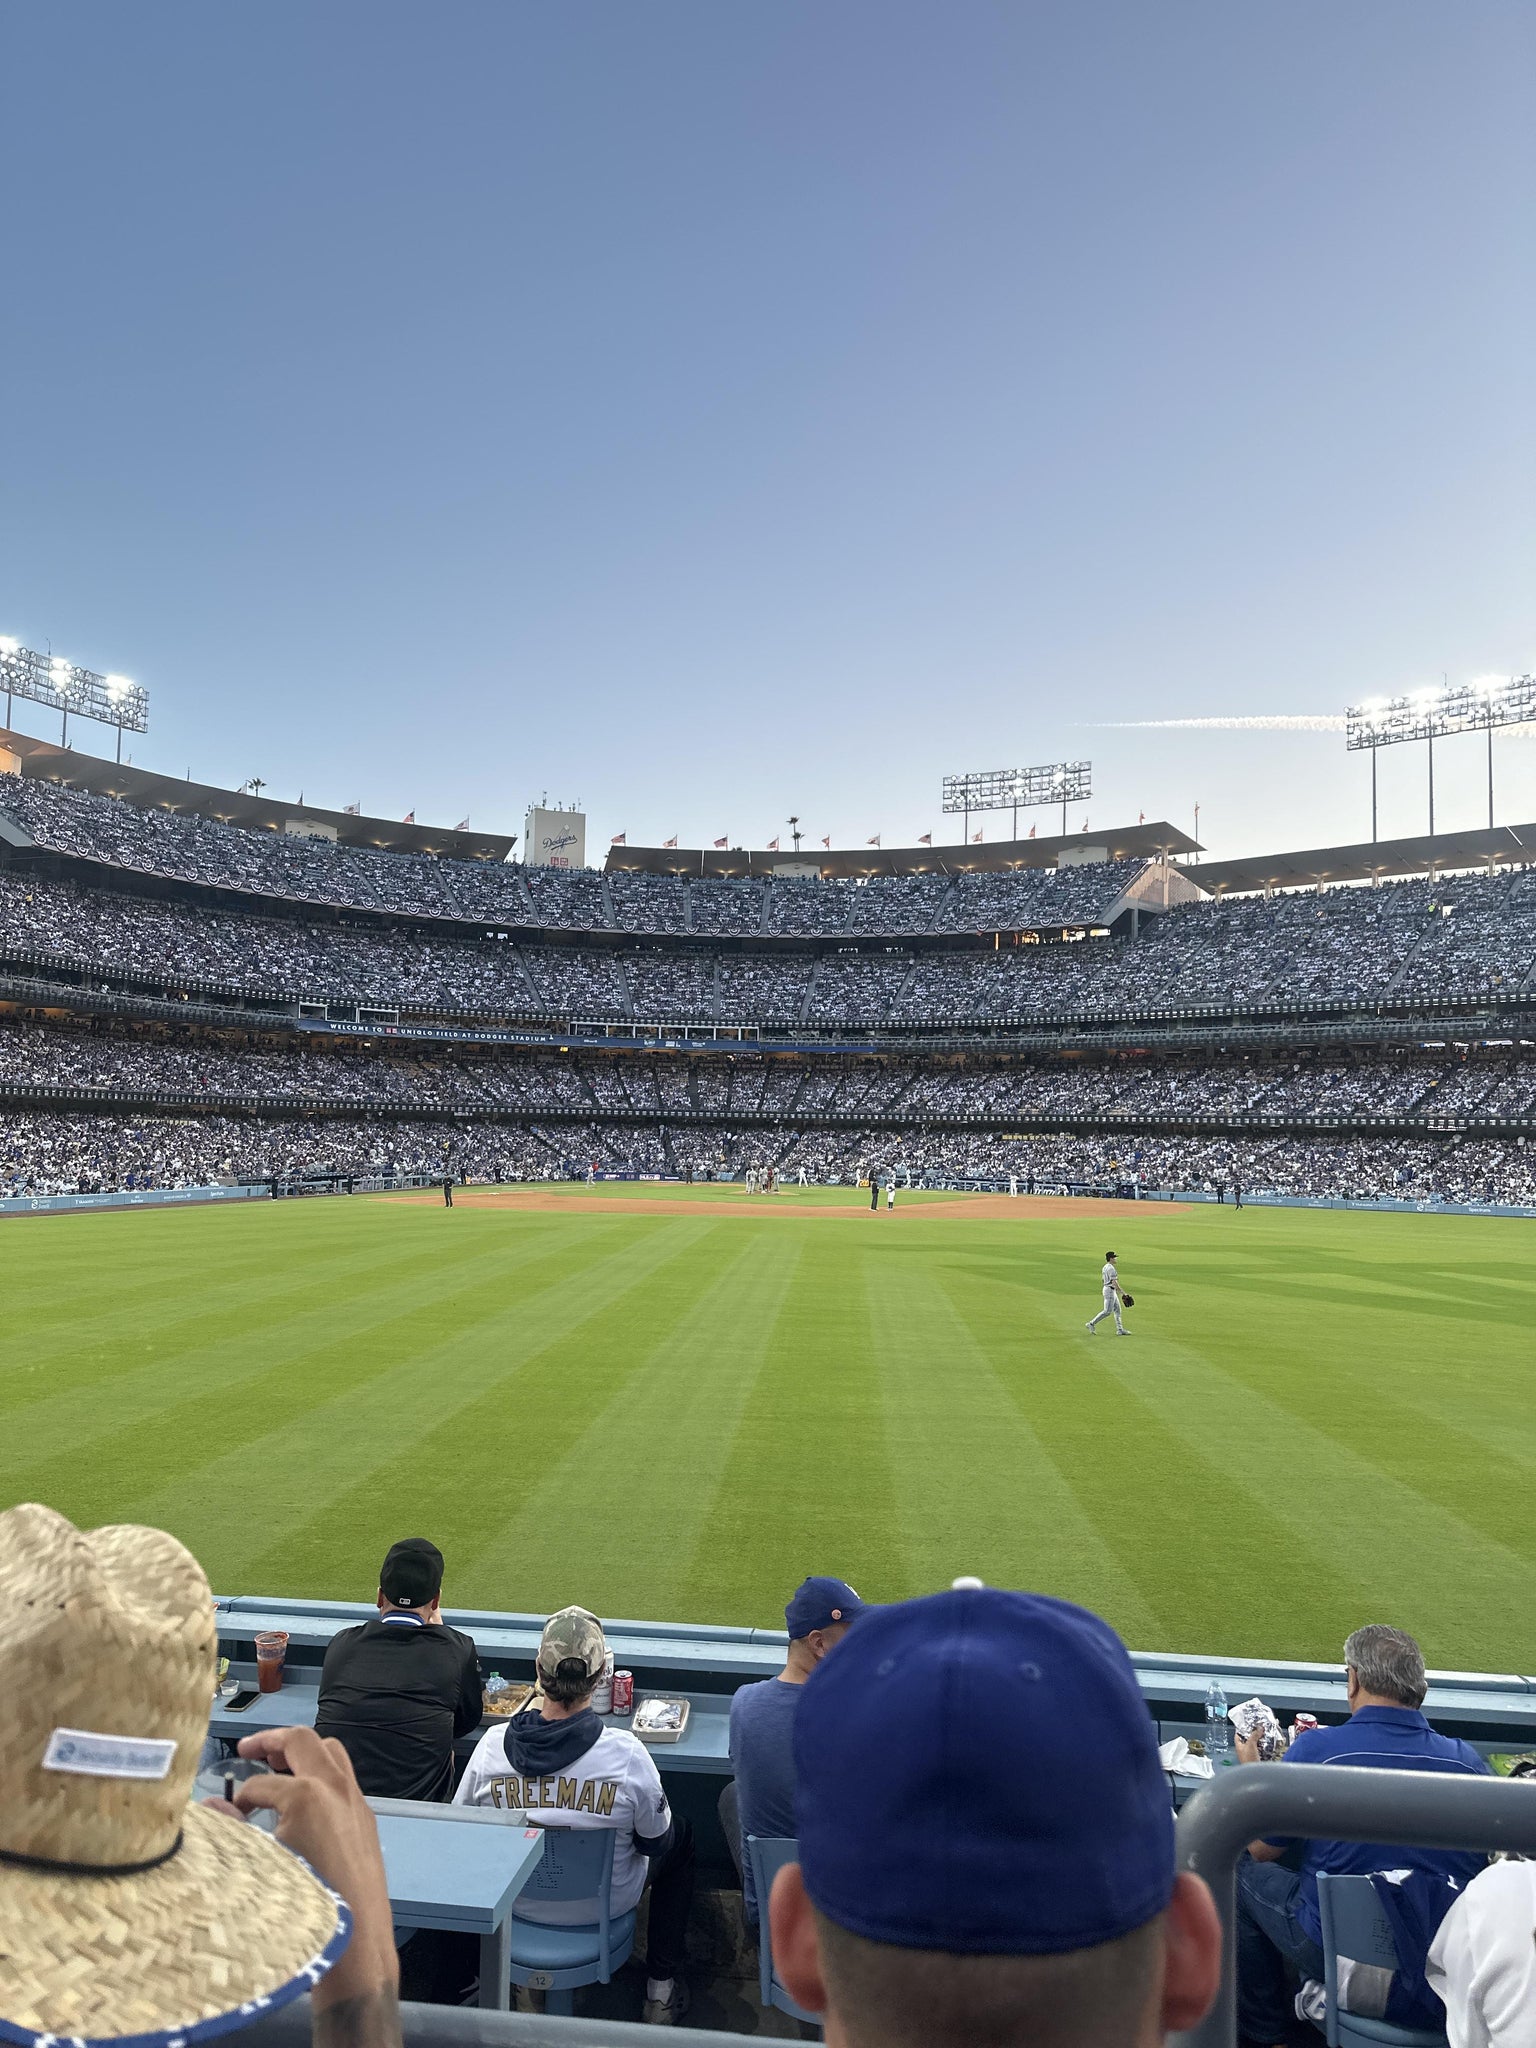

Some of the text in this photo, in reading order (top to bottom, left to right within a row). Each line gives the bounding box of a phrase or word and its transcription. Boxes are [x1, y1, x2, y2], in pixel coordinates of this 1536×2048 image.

[542, 834, 578, 850] Dodgers
[330, 1023, 369, 1032] WELCOME
[400, 1028, 433, 1036] UNIQLO
[490, 1775, 617, 1816] FREEMAN
[535, 1976, 546, 1986] 12
